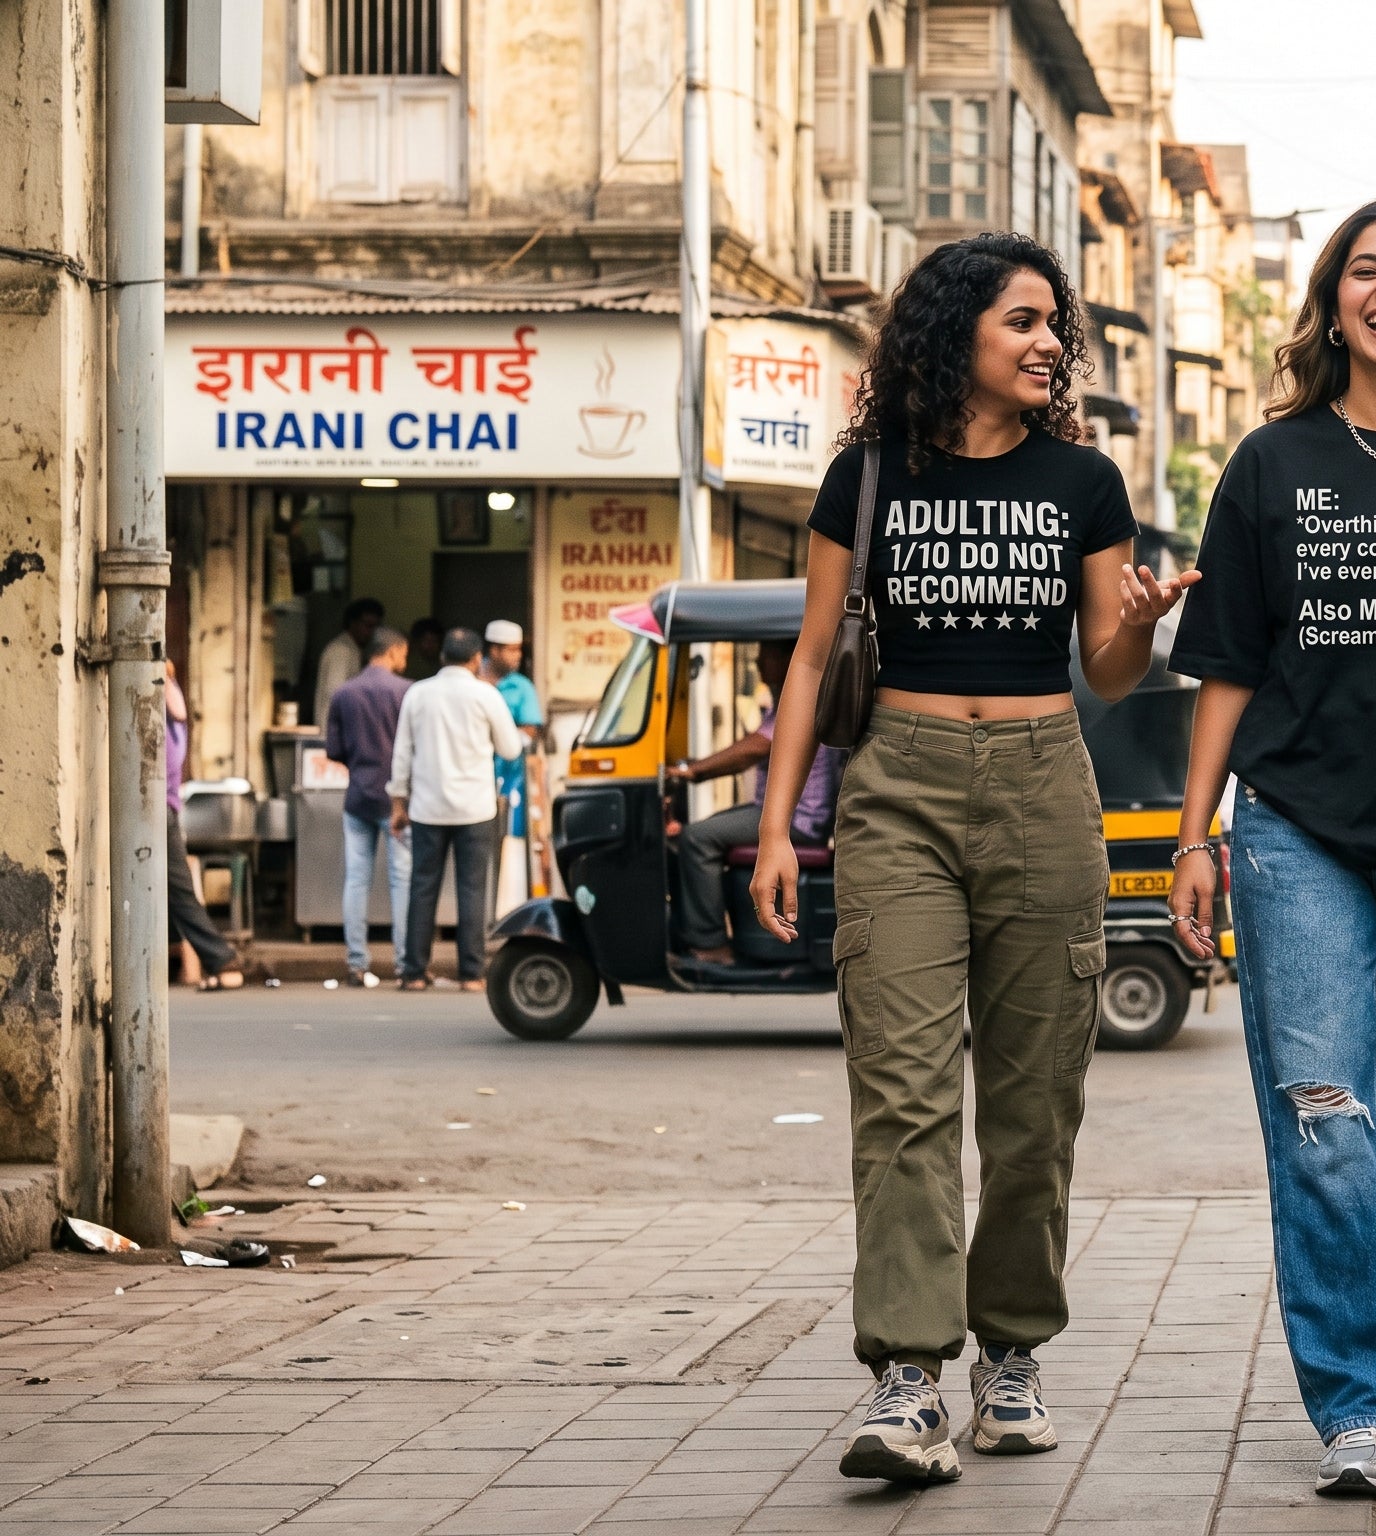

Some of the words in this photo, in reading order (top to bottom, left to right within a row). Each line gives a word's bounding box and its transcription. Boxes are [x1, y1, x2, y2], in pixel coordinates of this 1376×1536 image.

[410, 325, 540, 404] चाई
[217, 411, 365, 450] IRANI
[387, 411, 518, 451] CHAI
[1296, 488, 1340, 511] ME:
[884, 499, 1070, 539] ADULTING:
[890, 541, 950, 572] 1/10
[960, 541, 999, 570] DO
[1008, 542, 1064, 572] NOT
[1296, 542, 1352, 561] every
[887, 574, 1067, 606] RECOMMEND
[1298, 598, 1352, 621] Also
